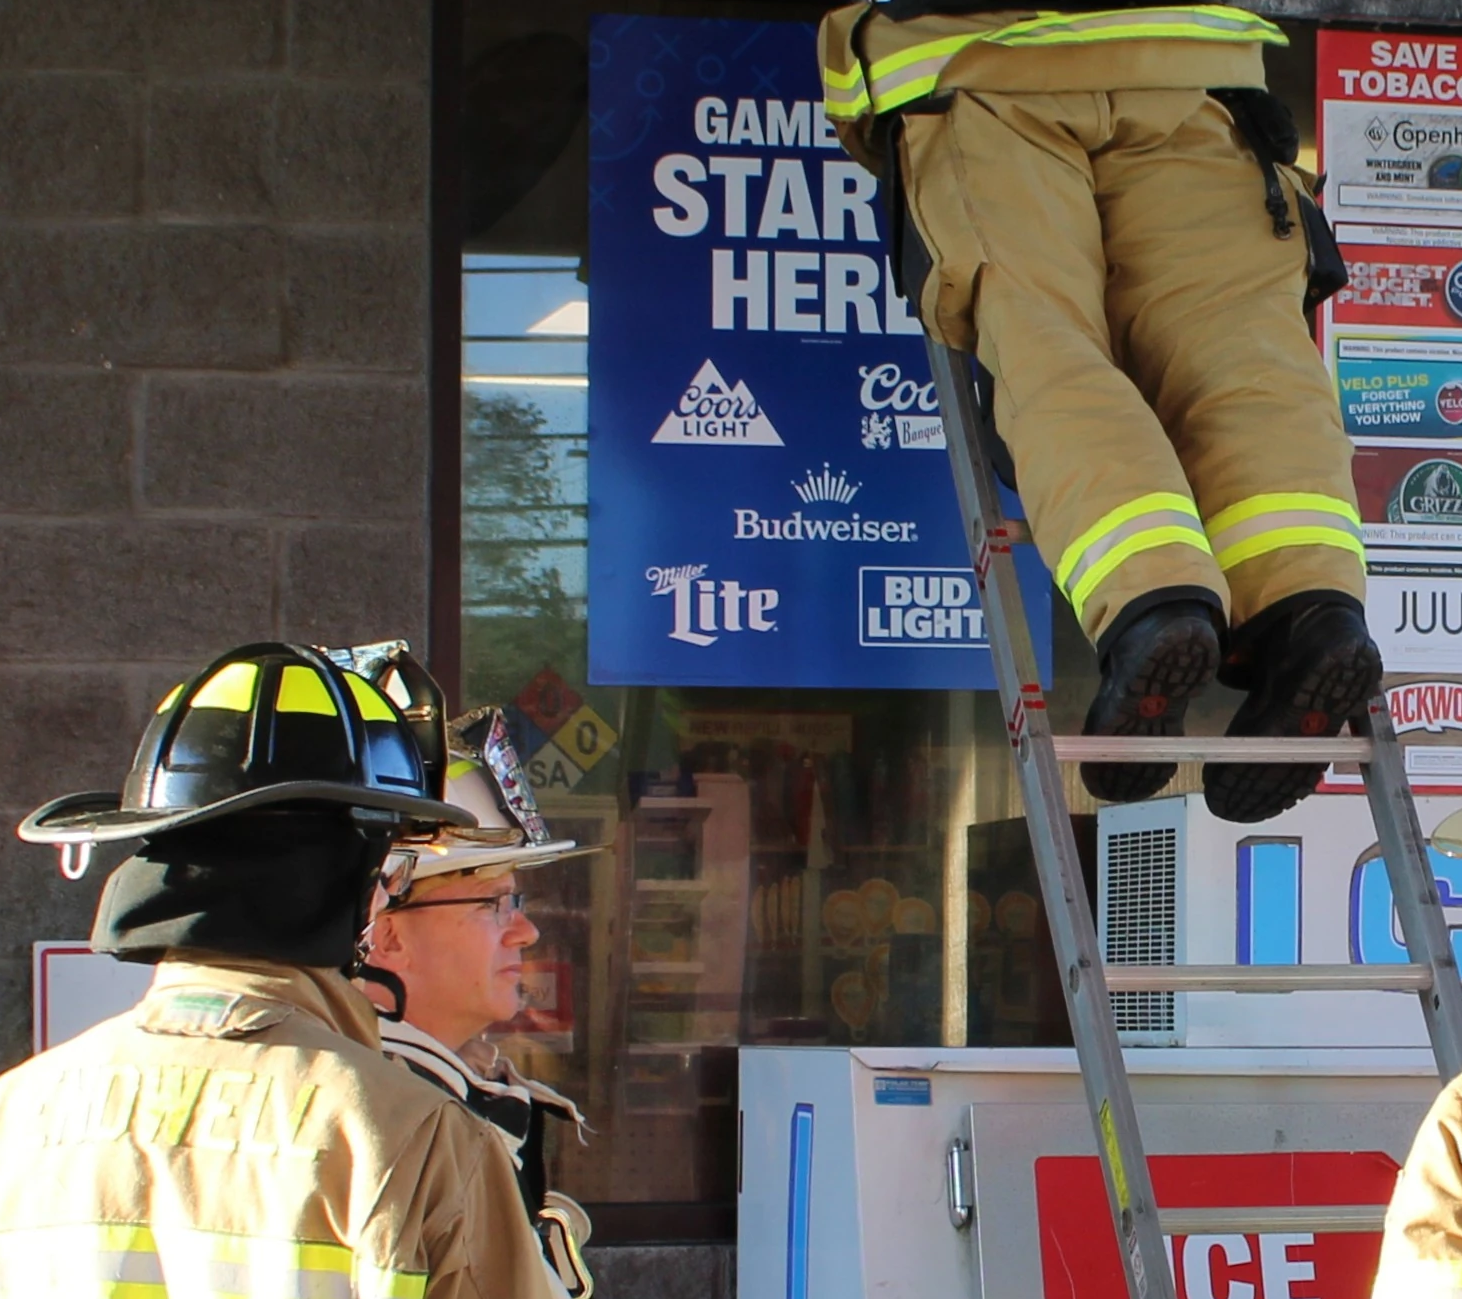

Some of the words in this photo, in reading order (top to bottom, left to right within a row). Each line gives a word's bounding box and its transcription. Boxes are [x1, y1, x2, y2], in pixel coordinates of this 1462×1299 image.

[1371, 41, 1457, 69] SAVE
[695, 97, 840, 148] GAME
[1366, 160, 1422, 169] WINTERGREEN
[1393, 174, 1414, 183] MINT
[653, 153, 880, 242] STAR
[1341, 377, 1383, 391] VELO
[1387, 374, 1429, 388] PLUS
[1361, 389, 1411, 402] FORGET
[672, 386, 761, 422] Coors
[1348, 400, 1426, 415] EVERYTHING
[682, 418, 750, 438] LIGHT
[1354, 414, 1386, 426] YOU
[1387, 412, 1422, 425] KNOW
[734, 508, 913, 542] Budweiser
[1389, 530, 1407, 540] This
[1408, 531, 1439, 542] product
[1440, 532, 1456, 541] can
[645, 564, 709, 597] Miller
[885, 577, 971, 607] BUD
[669, 579, 779, 647] Lite
[868, 607, 984, 639] LIGHT
[575, 720, 598, 755] 0
